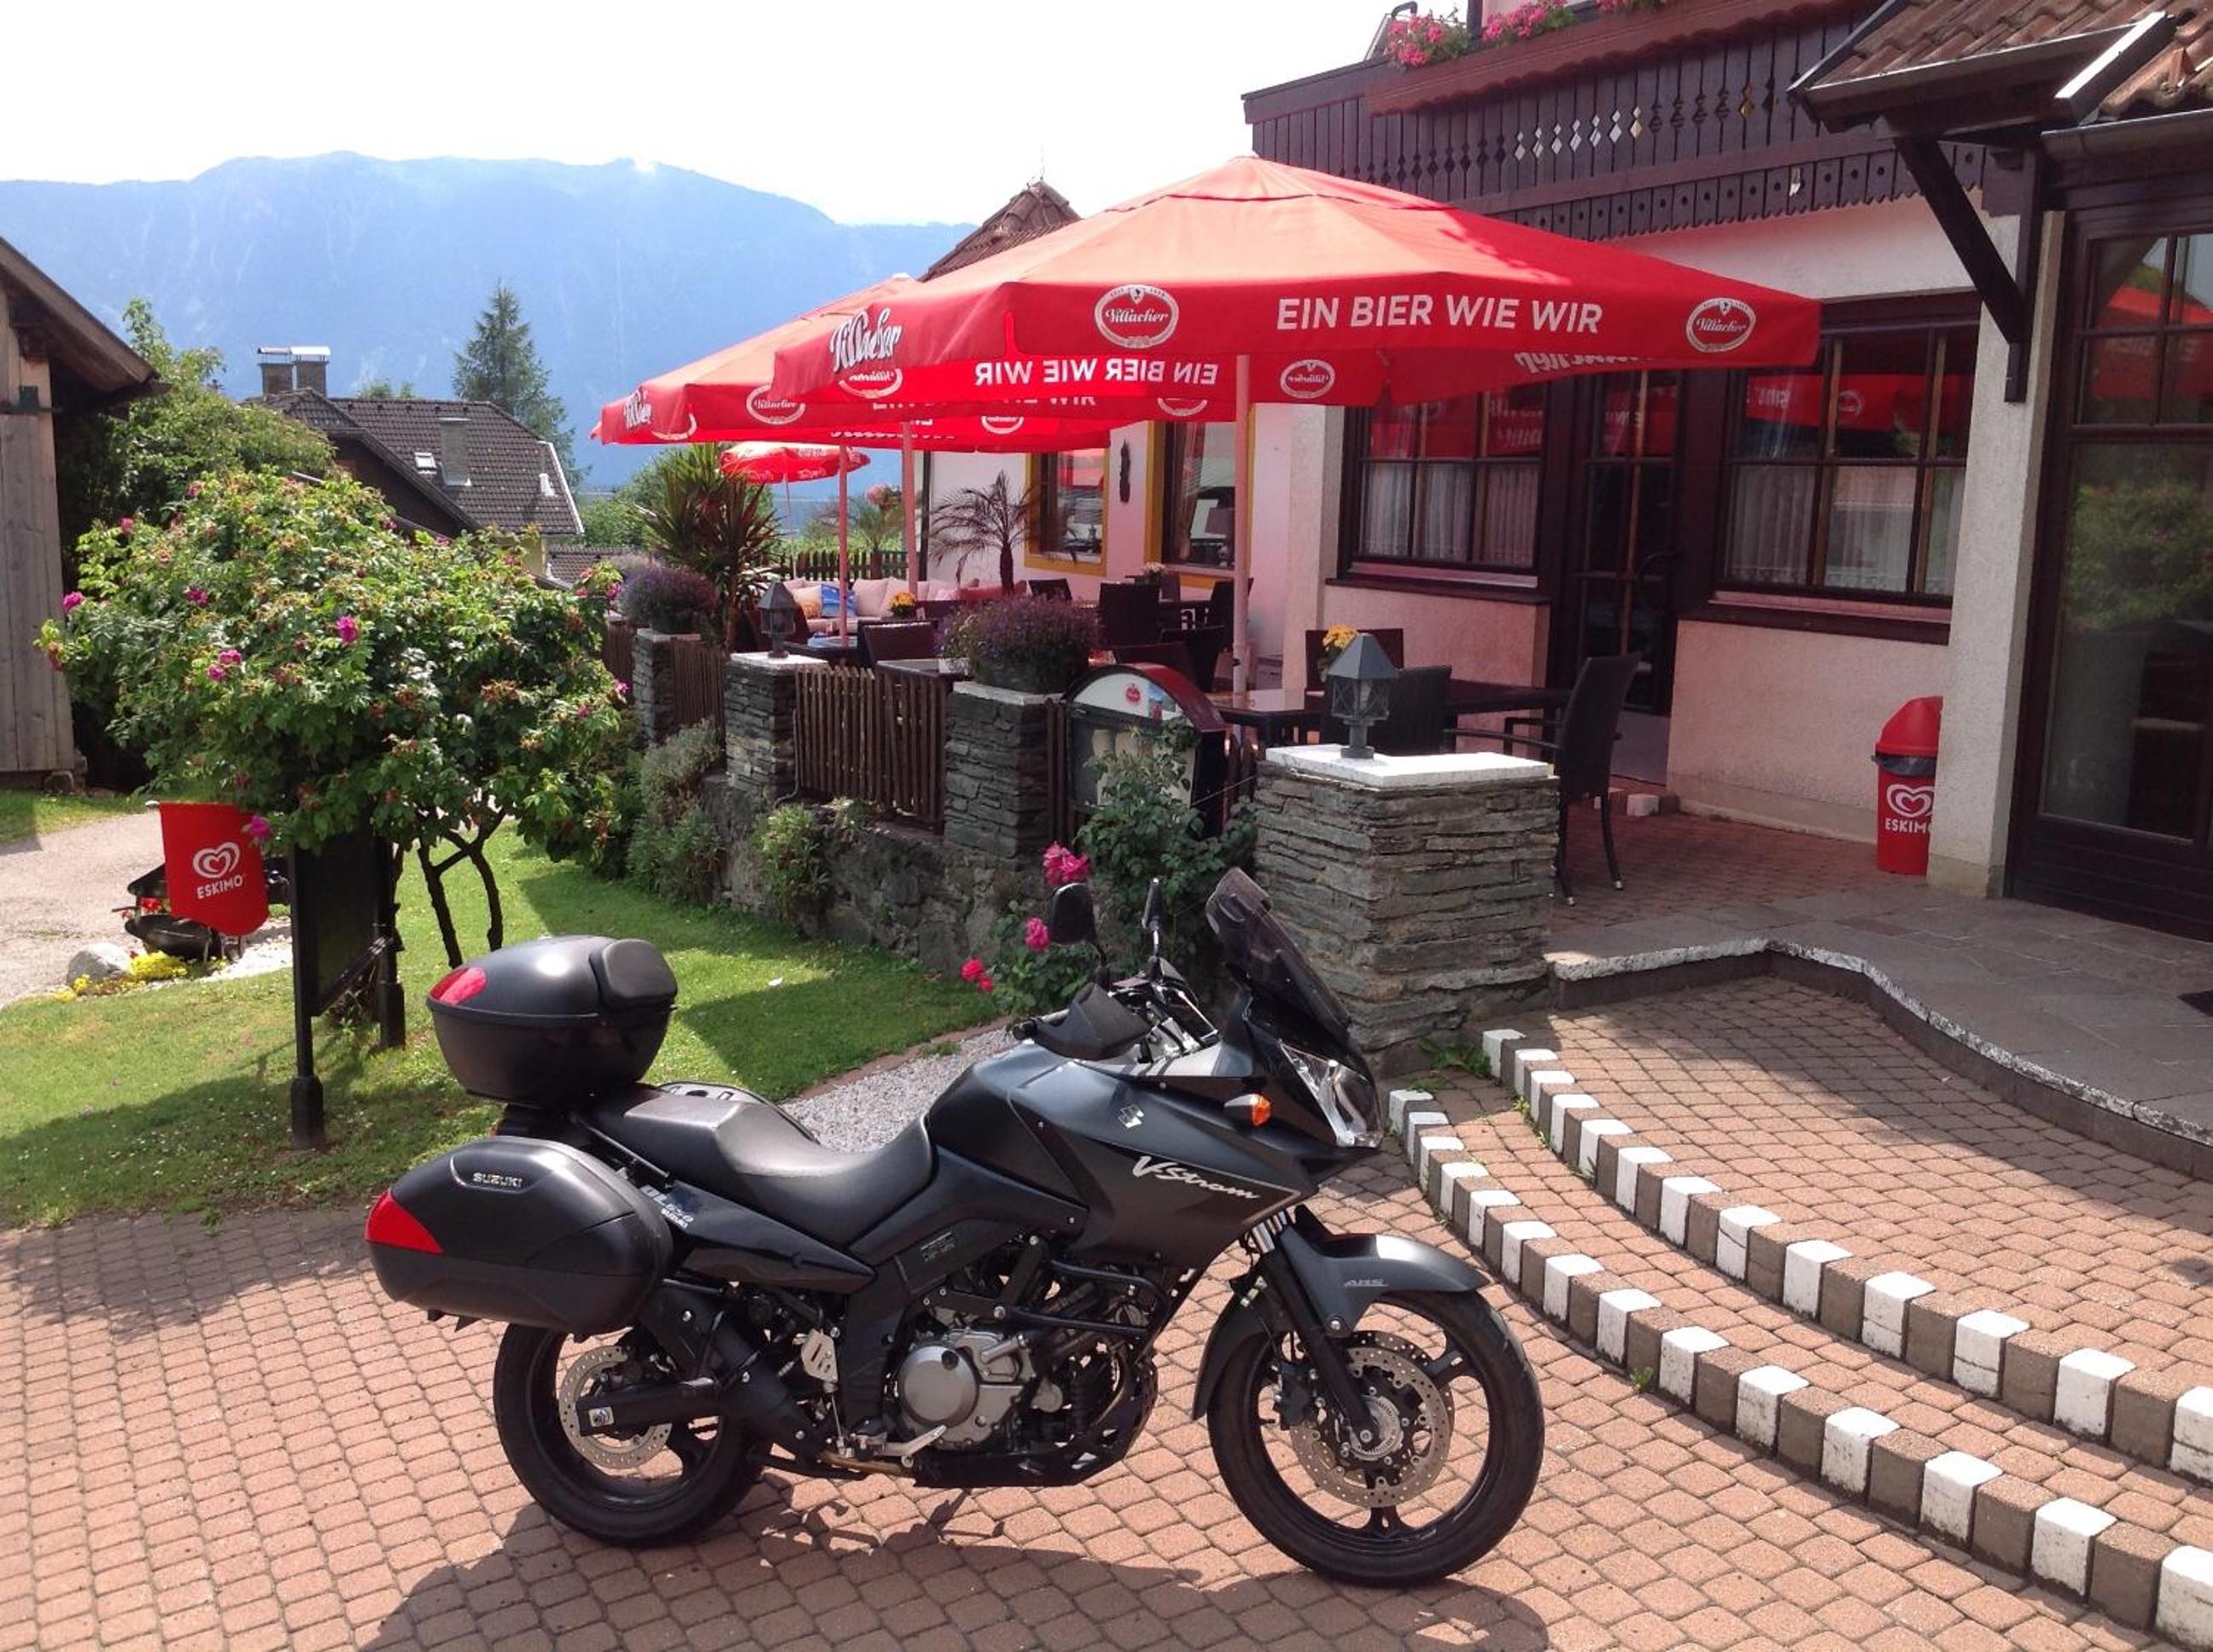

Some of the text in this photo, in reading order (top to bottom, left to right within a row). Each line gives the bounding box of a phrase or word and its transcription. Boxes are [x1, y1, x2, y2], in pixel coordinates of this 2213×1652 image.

[1276, 295, 1603, 333] EIN BIER WIE WIR
[197, 874, 243, 899] ESKIMO
[472, 1172, 523, 1188] SUZUKI
